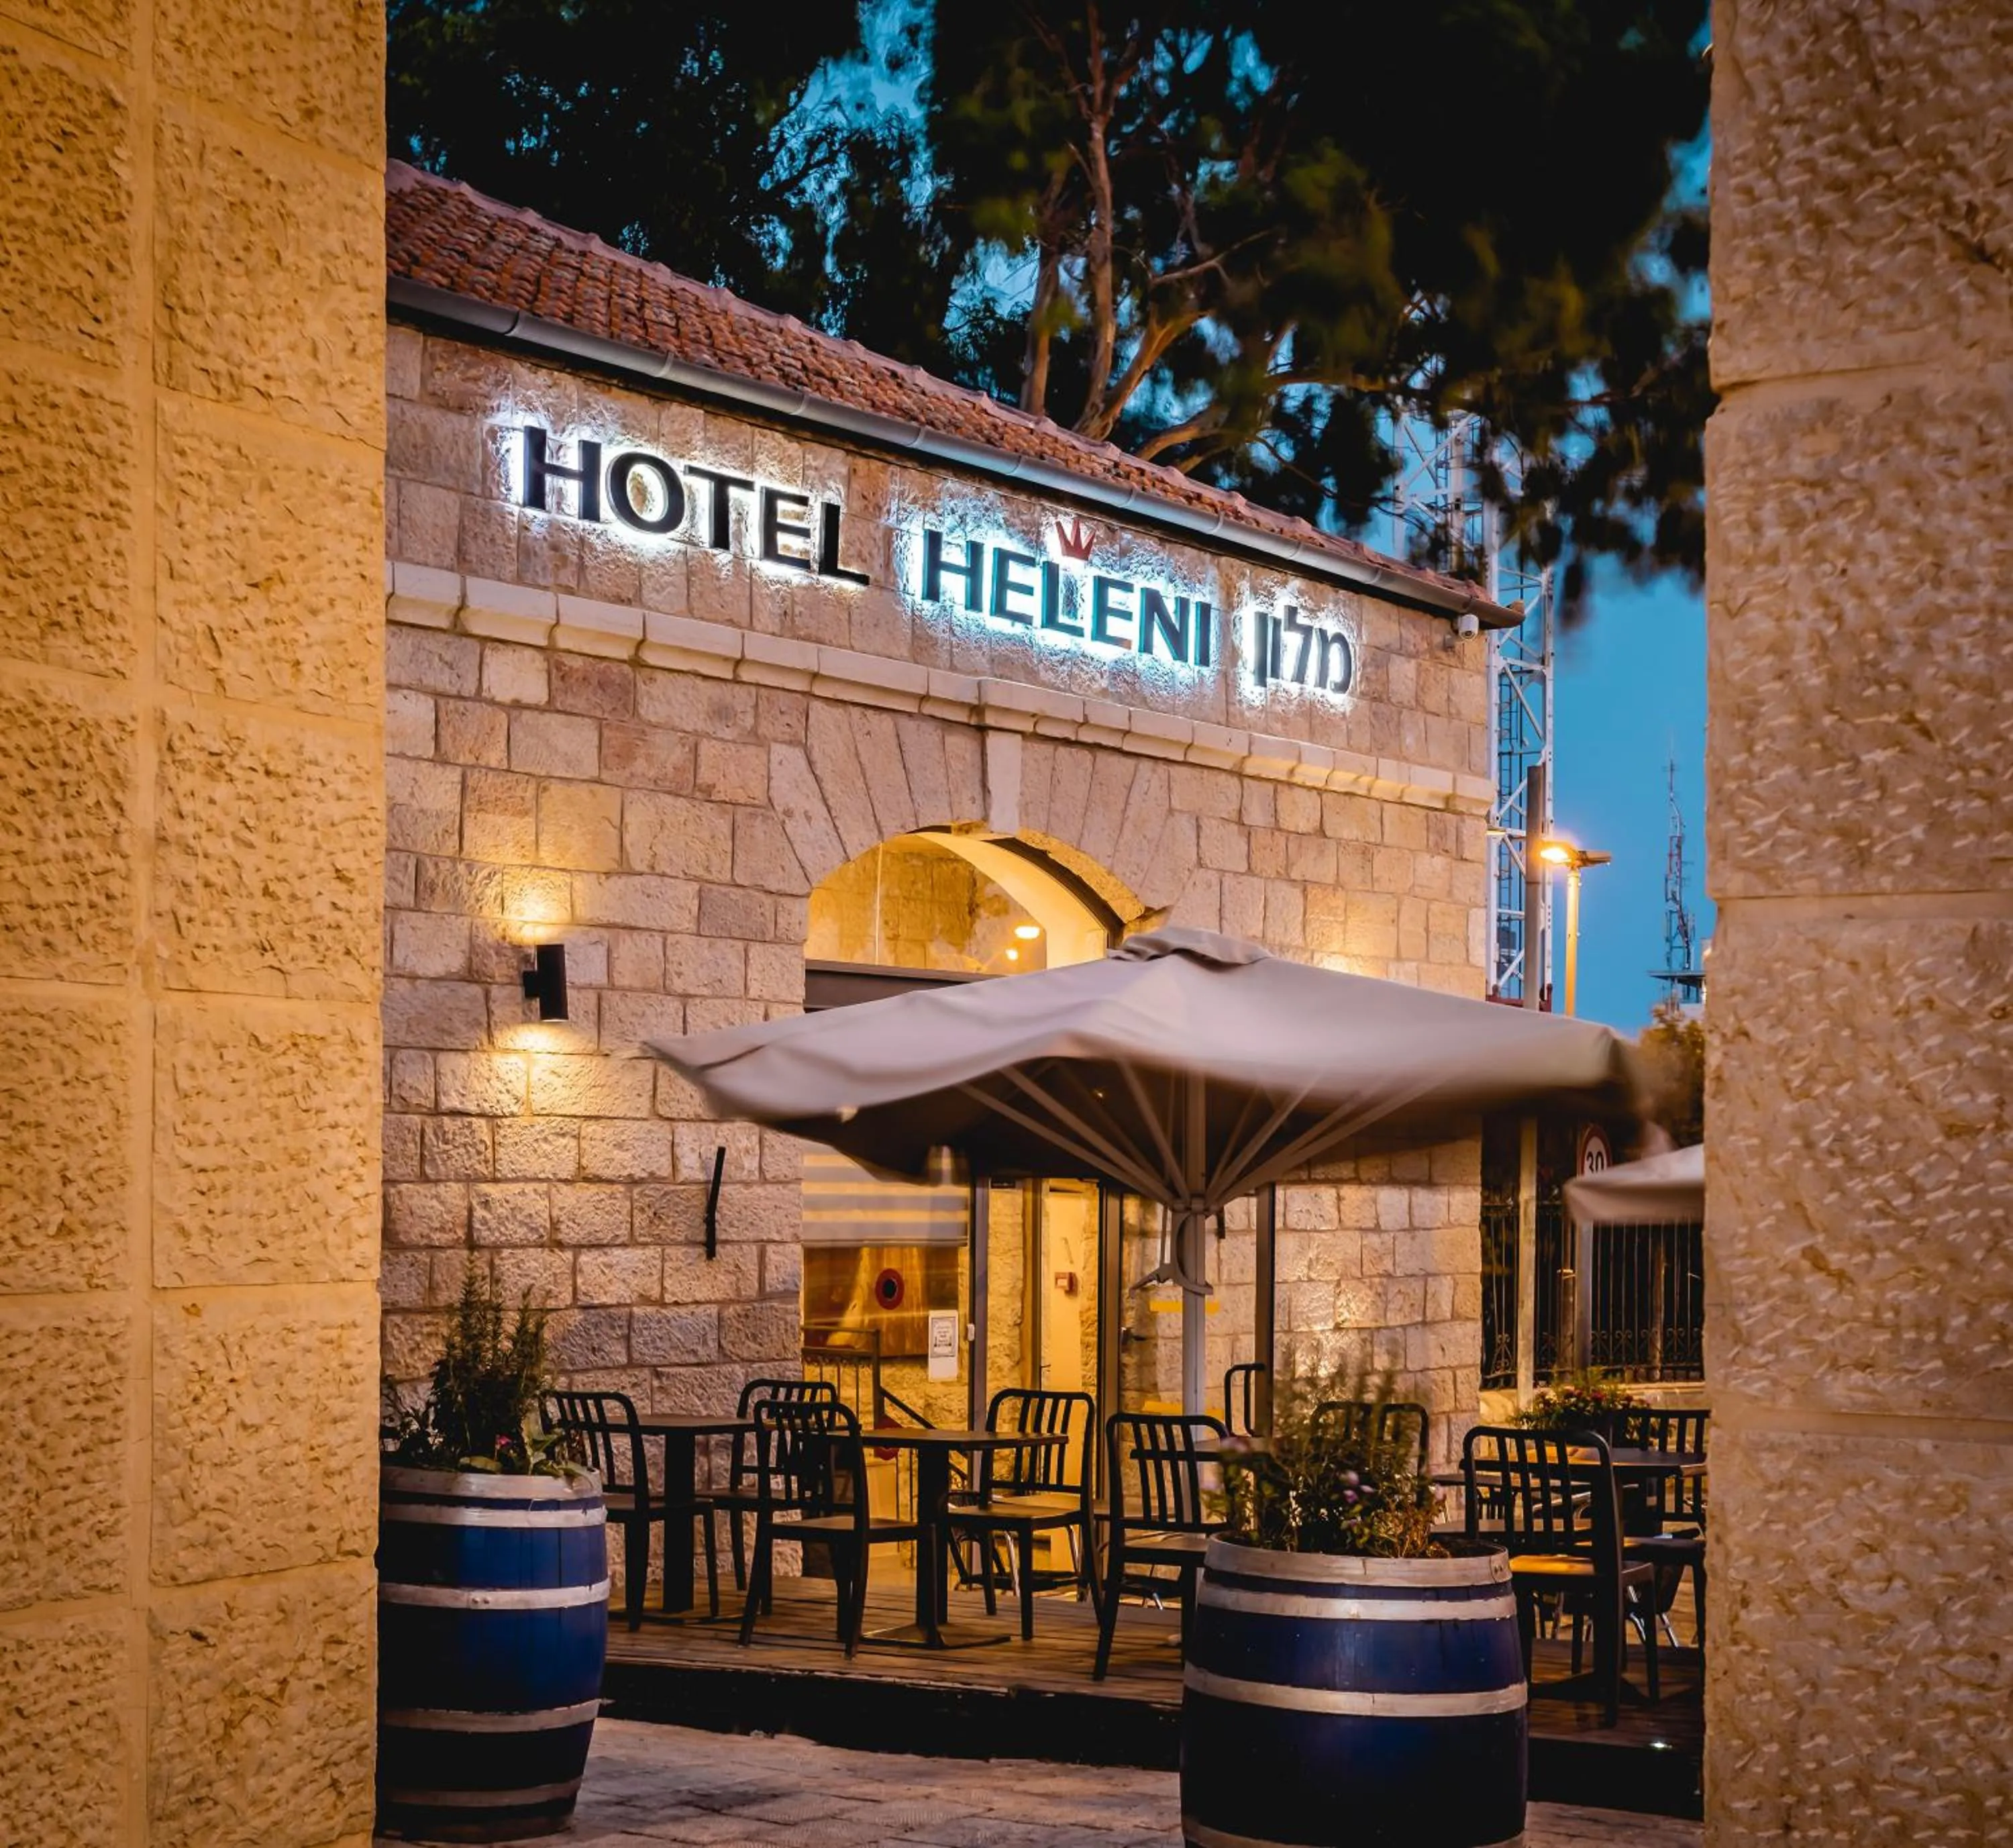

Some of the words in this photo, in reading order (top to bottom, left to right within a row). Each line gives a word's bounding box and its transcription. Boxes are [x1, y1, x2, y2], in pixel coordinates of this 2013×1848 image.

[523, 425, 870, 586] HOTEL
[921, 528, 1212, 668] HELENI
[1254, 605, 1352, 695] מלון
[1586, 1151, 1604, 1174] 30
